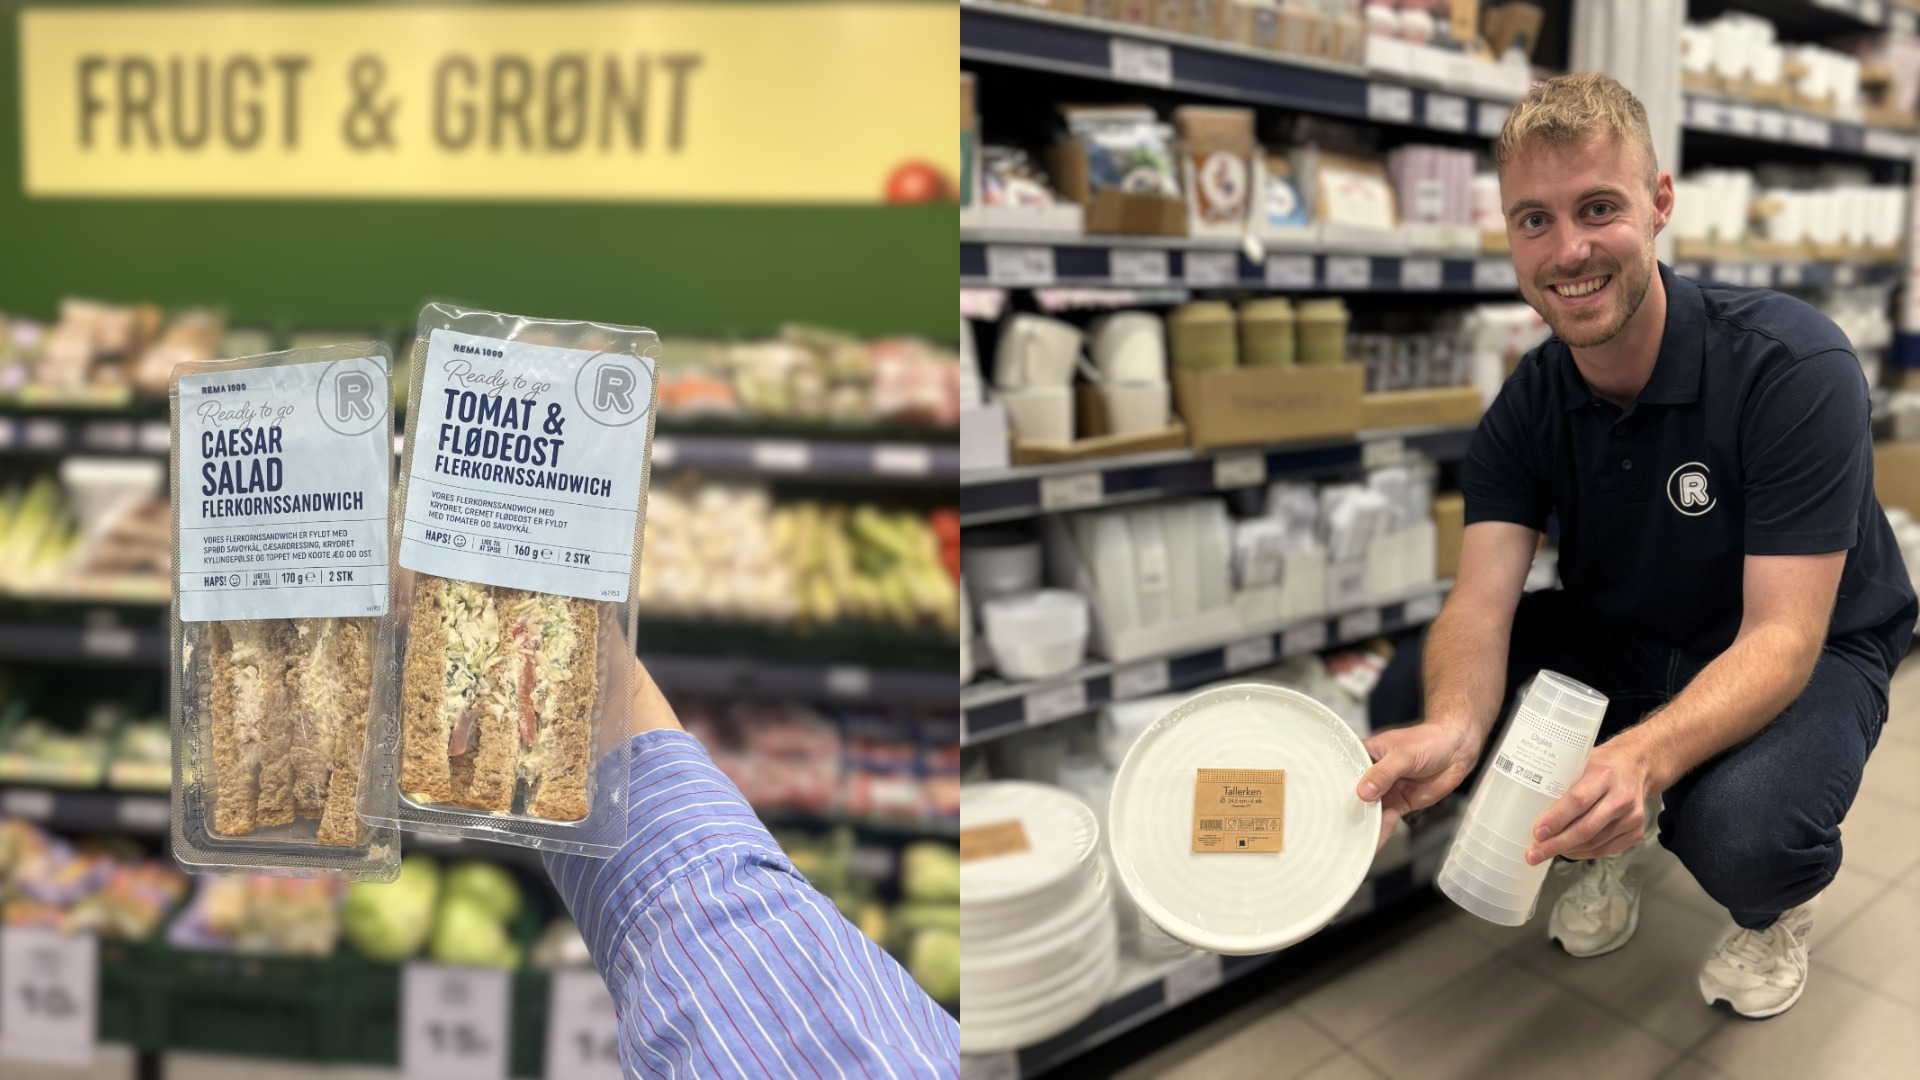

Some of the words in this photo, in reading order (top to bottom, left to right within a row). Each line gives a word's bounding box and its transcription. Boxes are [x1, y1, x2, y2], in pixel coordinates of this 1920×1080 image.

[76, 54, 310, 153] FRUGT
[342, 53, 401, 153] &
[431, 52, 704, 156] GRØNT
[453, 343, 480, 355] REMA
[481, 347, 504, 359] 1000
[202, 384, 226, 395] REMA
[227, 383, 247, 393] 1000
[443, 359, 510, 398] Ready
[513, 373, 527, 390] to
[523, 381, 551, 401] go
[592, 363, 637, 415] R
[334, 370, 375, 422] R
[197, 400, 257, 432] Ready
[260, 401, 273, 417] to
[271, 405, 294, 429] go
[444, 388, 537, 431] TOMAT
[542, 402, 566, 436] &
[202, 426, 283, 459] CAESAR
[438, 423, 565, 468] FLØDEOST
[202, 457, 283, 496] SALAD
[434, 454, 612, 498] FLERKORNSSANDWICH
[202, 491, 363, 518] FLERKORNSSANDWICH
[430, 500, 463, 515] KRYDRET,
[464, 507, 494, 519] CREMET
[495, 511, 532, 524] FLØDEOST
[533, 517, 544, 526] ER
[545, 518, 568, 529] FYLDT
[431, 490, 455, 502] VORES
[456, 495, 537, 514] FLERKORNSSANDWICH
[538, 507, 555, 517] MED
[203, 536, 224, 544] VORES
[226, 532, 297, 543] FLERKORNSSANDWICH
[299, 531, 308, 539] ER
[309, 530, 330, 538] FYLDT
[332, 529, 348, 537] MED
[428, 510, 444, 520] MED
[446, 514, 479, 527] TOMATER
[480, 520, 491, 529] OG
[493, 521, 533, 535] SAVOYKÅL.
[203, 545, 226, 554] SPRØD
[227, 542, 261, 553] SAVOYKÅL,
[263, 541, 321, 552] CÆSARDRESSING,
[323, 540, 355, 548] KRYDRET
[425, 529, 451, 545] HAPS!
[514, 544, 531, 557] 160
[532, 549, 539, 560] g
[565, 552, 571, 563] 2
[573, 552, 591, 565] STK
[481, 538, 492, 546] LIGE
[486, 546, 502, 554] SPISE
[203, 554, 254, 564] KYLLINGEPØLSE
[255, 554, 265, 562] OG
[266, 552, 290, 561] TOPPET
[292, 551, 306, 560] MED
[308, 551, 330, 559] KOGTE
[332, 550, 344, 558] ÆG
[346, 550, 356, 558] OG
[358, 549, 372, 558] OST.
[204, 576, 227, 587] HAPS!
[281, 572, 295, 583] 170
[297, 574, 303, 585] g
[329, 571, 334, 582] 2
[336, 570, 354, 582] STK
[1222, 786, 1262, 796] Tallerken
